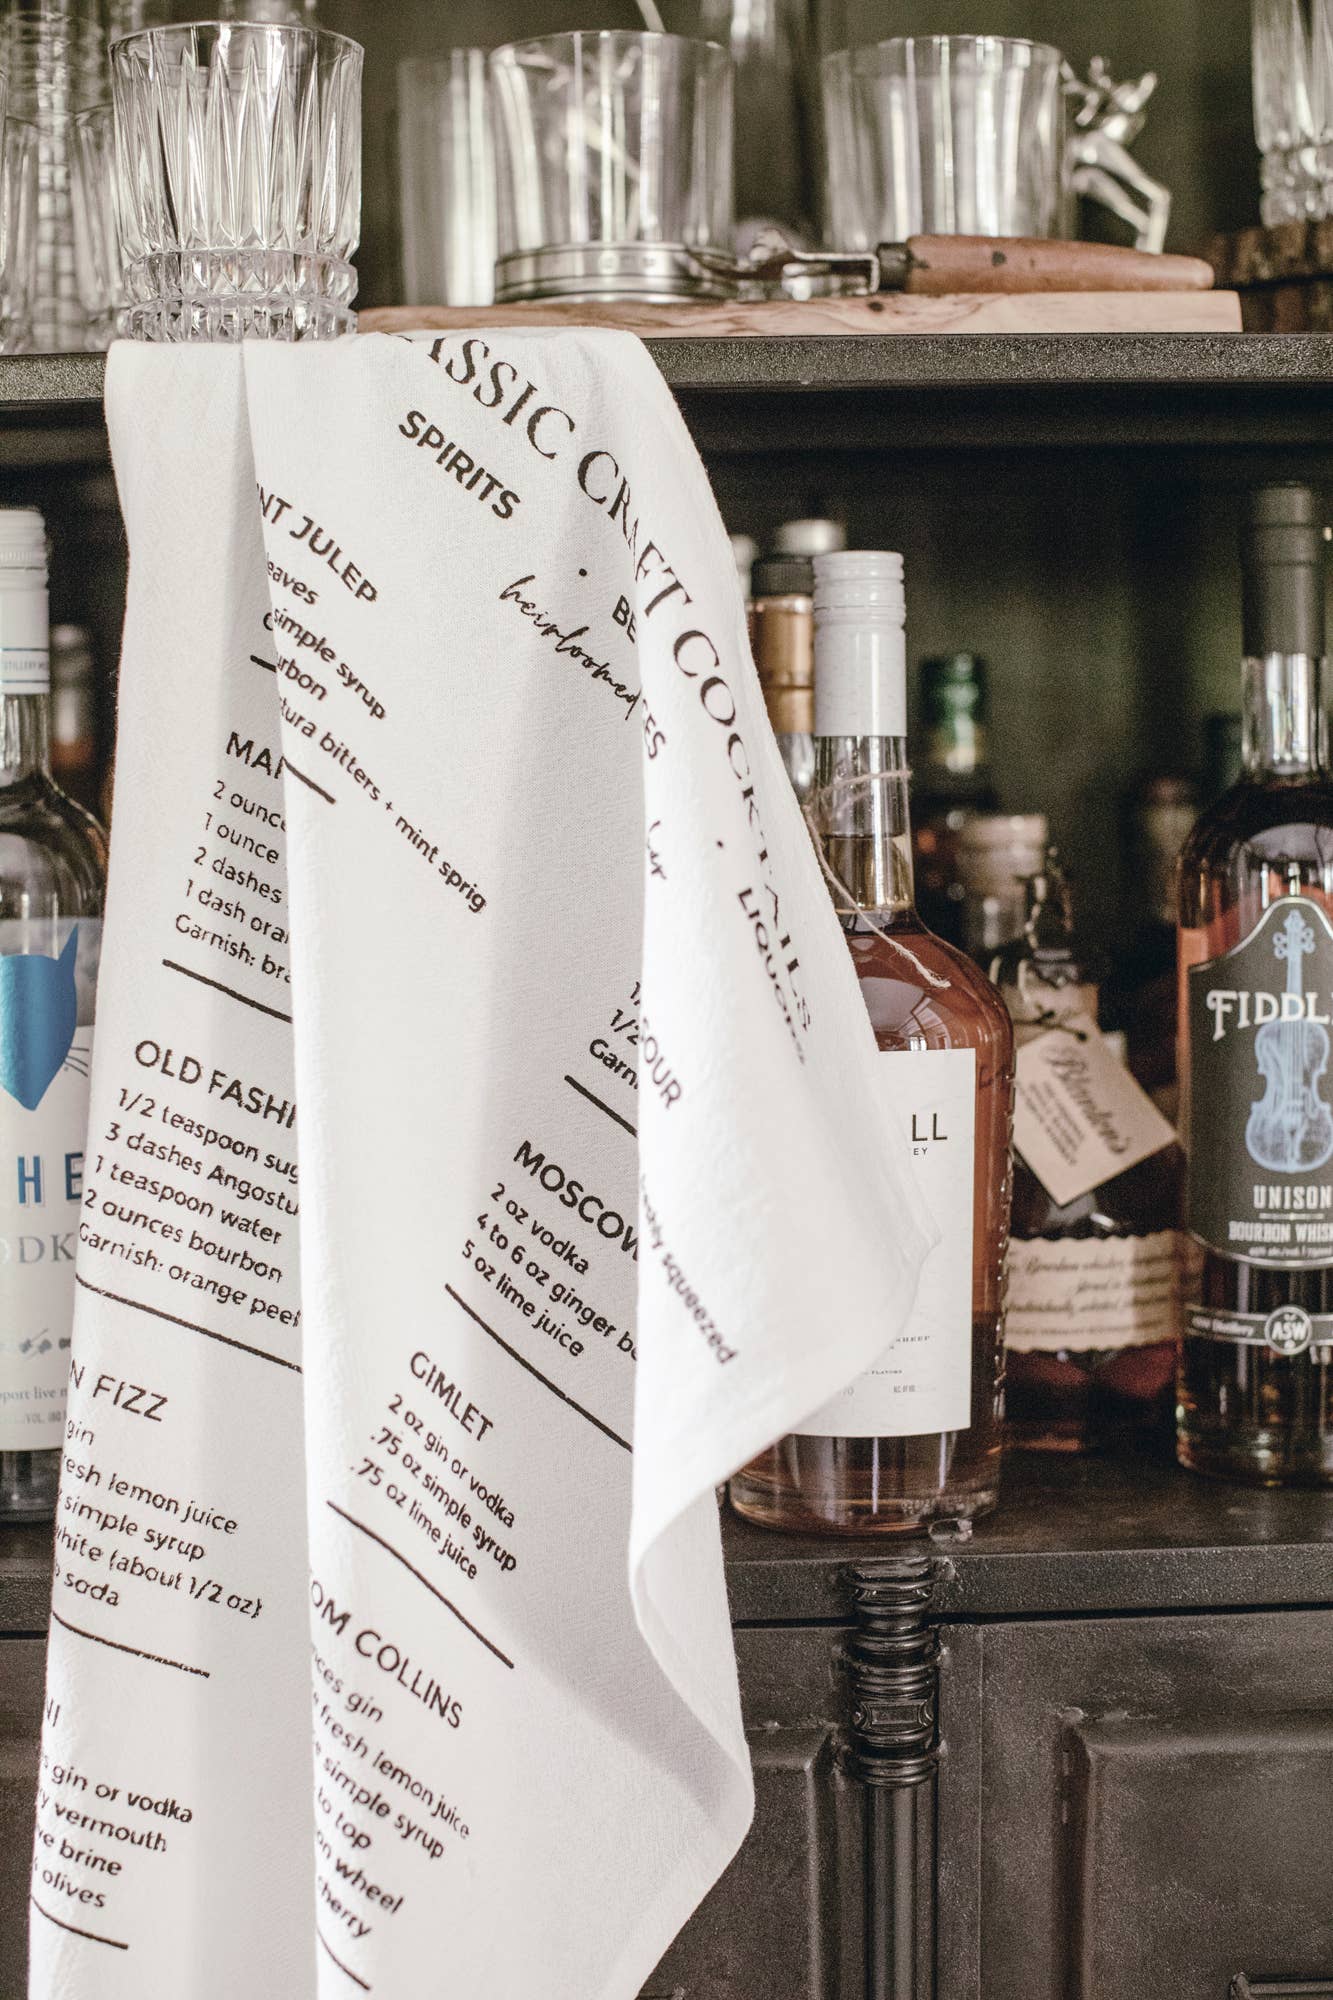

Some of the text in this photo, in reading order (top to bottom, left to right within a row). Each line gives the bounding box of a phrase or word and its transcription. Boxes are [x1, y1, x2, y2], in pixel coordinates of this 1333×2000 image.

[399, 410, 521, 519] SPIRITS
[256, 483, 379, 602] NT JULEP
[266, 552, 320, 605] eaves
[273, 608, 386, 720] simple syrup
[277, 655, 328, 701] rbon
[213, 780, 225, 800] 2
[204, 812, 280, 865] 1 ounce
[319, 732, 381, 801] bitters
[395, 815, 439, 864] mint
[438, 860, 487, 914] sprig
[185, 879, 194, 897] 1
[198, 883, 246, 923] dash
[193, 847, 283, 904] 2 dashes
[1206, 989, 1333, 1041] FIDDL
[134, 1040, 297, 1128] OLD FASHI
[589, 1038, 639, 1090] Garn
[105, 1122, 121, 1142] 3
[126, 1132, 203, 1175] dashes
[119, 1087, 156, 1118] 1/2
[162, 1105, 259, 1163] teaspoon
[911, 1113, 948, 1142] LL
[912, 1147, 929, 1156] EY
[95, 1155, 282, 1245] 1 teaspoon water
[1253, 1184, 1333, 1211] UNISON
[84, 1188, 283, 1283] 2 ounces bourbon
[490, 1182, 590, 1276] 2 oz vodka
[1229, 1221, 1292, 1244] BOURBON
[79, 1222, 302, 1328] Garnish: orange peel
[462, 1239, 584, 1358] 5 oz lime juice
[477, 1212, 490, 1231] 4
[490, 1223, 509, 1250] to
[510, 1244, 526, 1265] 6
[525, 1261, 551, 1287] oz
[550, 1281, 616, 1338] ginger
[1271, 1319, 1308, 1342] ASW
[92, 1374, 169, 1422] FIZZ
[409, 1351, 494, 1442] GIMLET
[65, 1419, 95, 1445] gin
[388, 1393, 515, 1528] 2 oz gin or vodka
[108, 1473, 179, 1515] lemon
[180, 1500, 239, 1535] juice
[350, 1458, 478, 1580] .75 oz lime juice
[370, 1426, 517, 1572] .75 oz simple syrup
[64, 1496, 206, 1562] simple syrup
[64, 1572, 120, 1607] soda
[189, 1576, 224, 1605] 1/2
[311, 1580, 464, 1729] OM COLLINS
[312, 1651, 384, 1723] ces gin
[51, 1763, 194, 1824] gin or vodka
[320, 1703, 470, 1841] fresh lemon juice
[54, 1802, 168, 1852] vermouth
[323, 1755, 446, 1861] simple syrup
[335, 1811, 372, 1849] top
[59, 1838, 123, 1876] brine
[335, 1857, 404, 1914] wheel
[42, 1867, 107, 1908] olives
